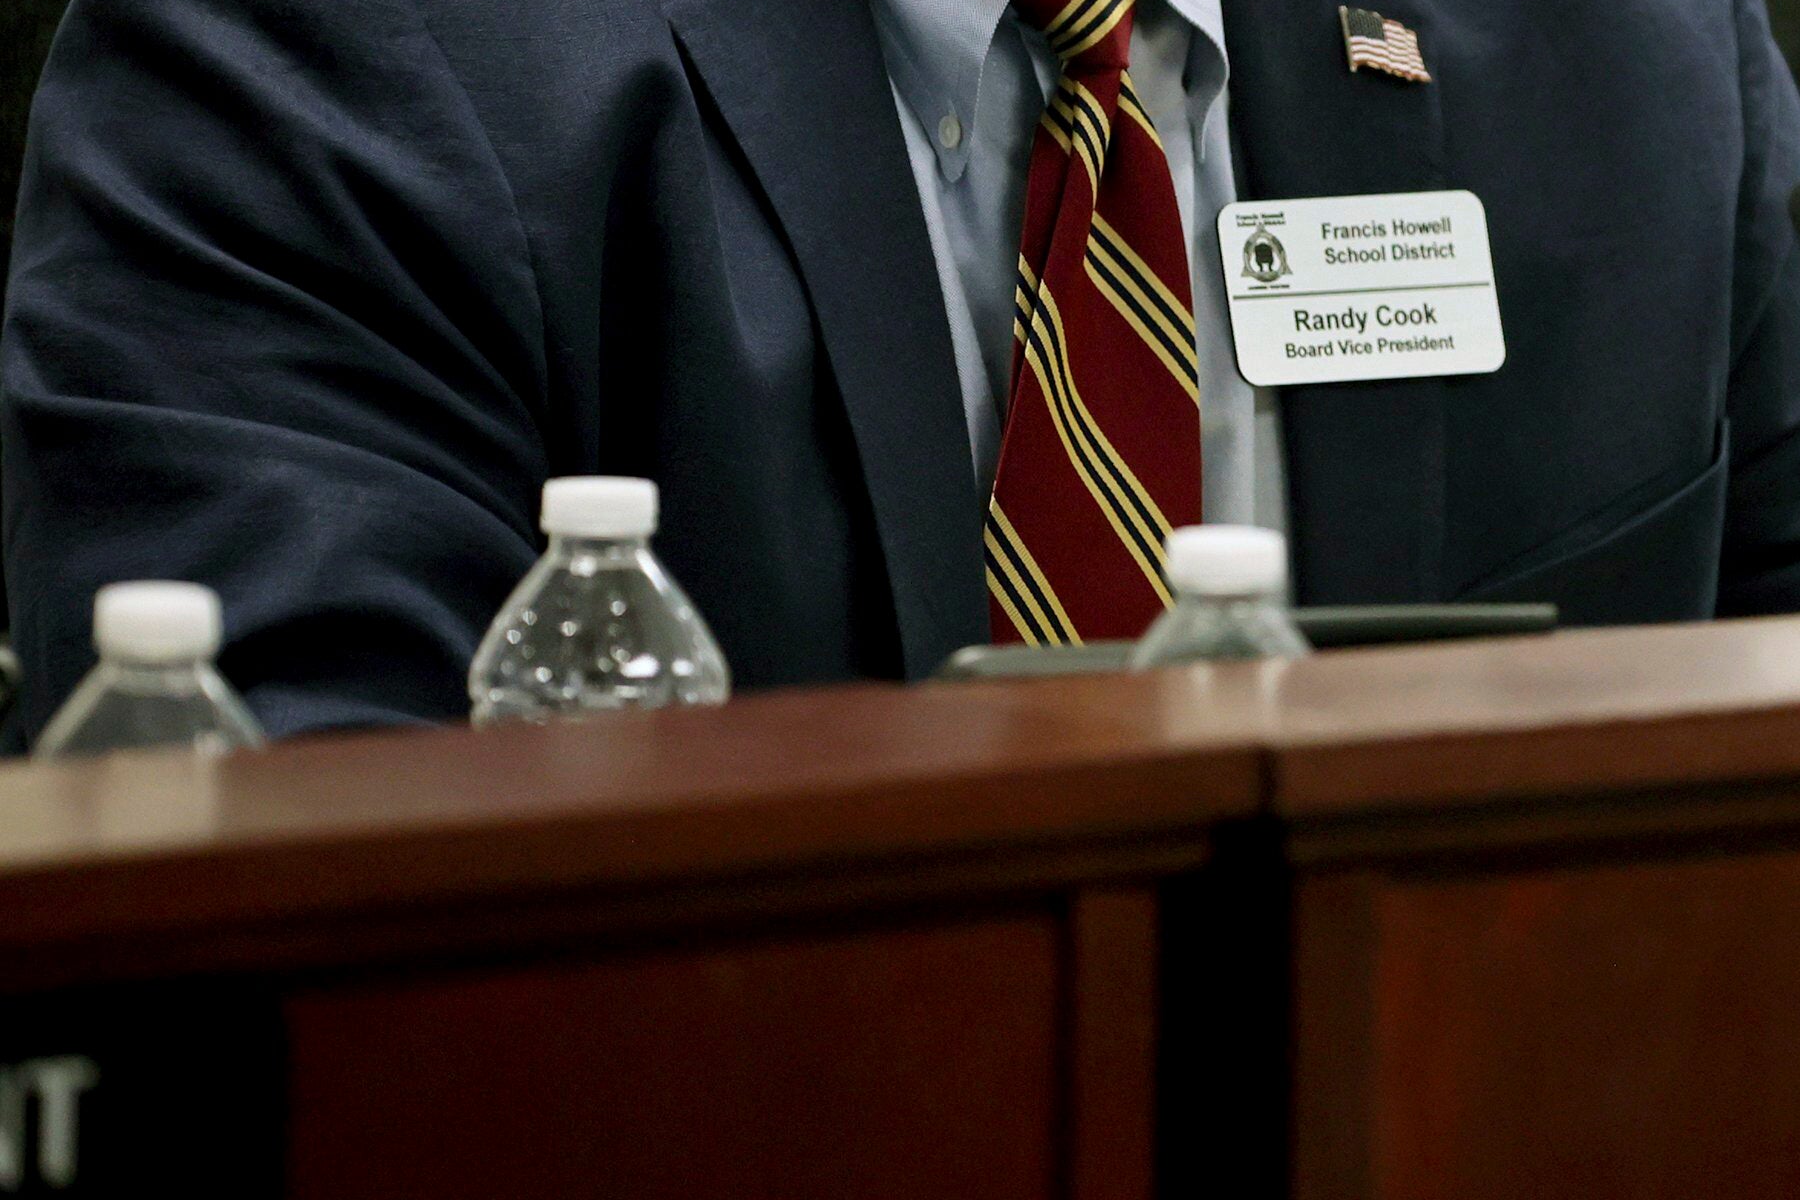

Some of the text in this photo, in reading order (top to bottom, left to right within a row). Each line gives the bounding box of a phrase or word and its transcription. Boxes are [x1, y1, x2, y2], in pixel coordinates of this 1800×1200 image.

[1322, 217, 1452, 240] Francis Howell
[1324, 243, 1455, 265] School District
[1293, 303, 1437, 334] Randy Cook
[1285, 335, 1455, 359] Board Vice President
